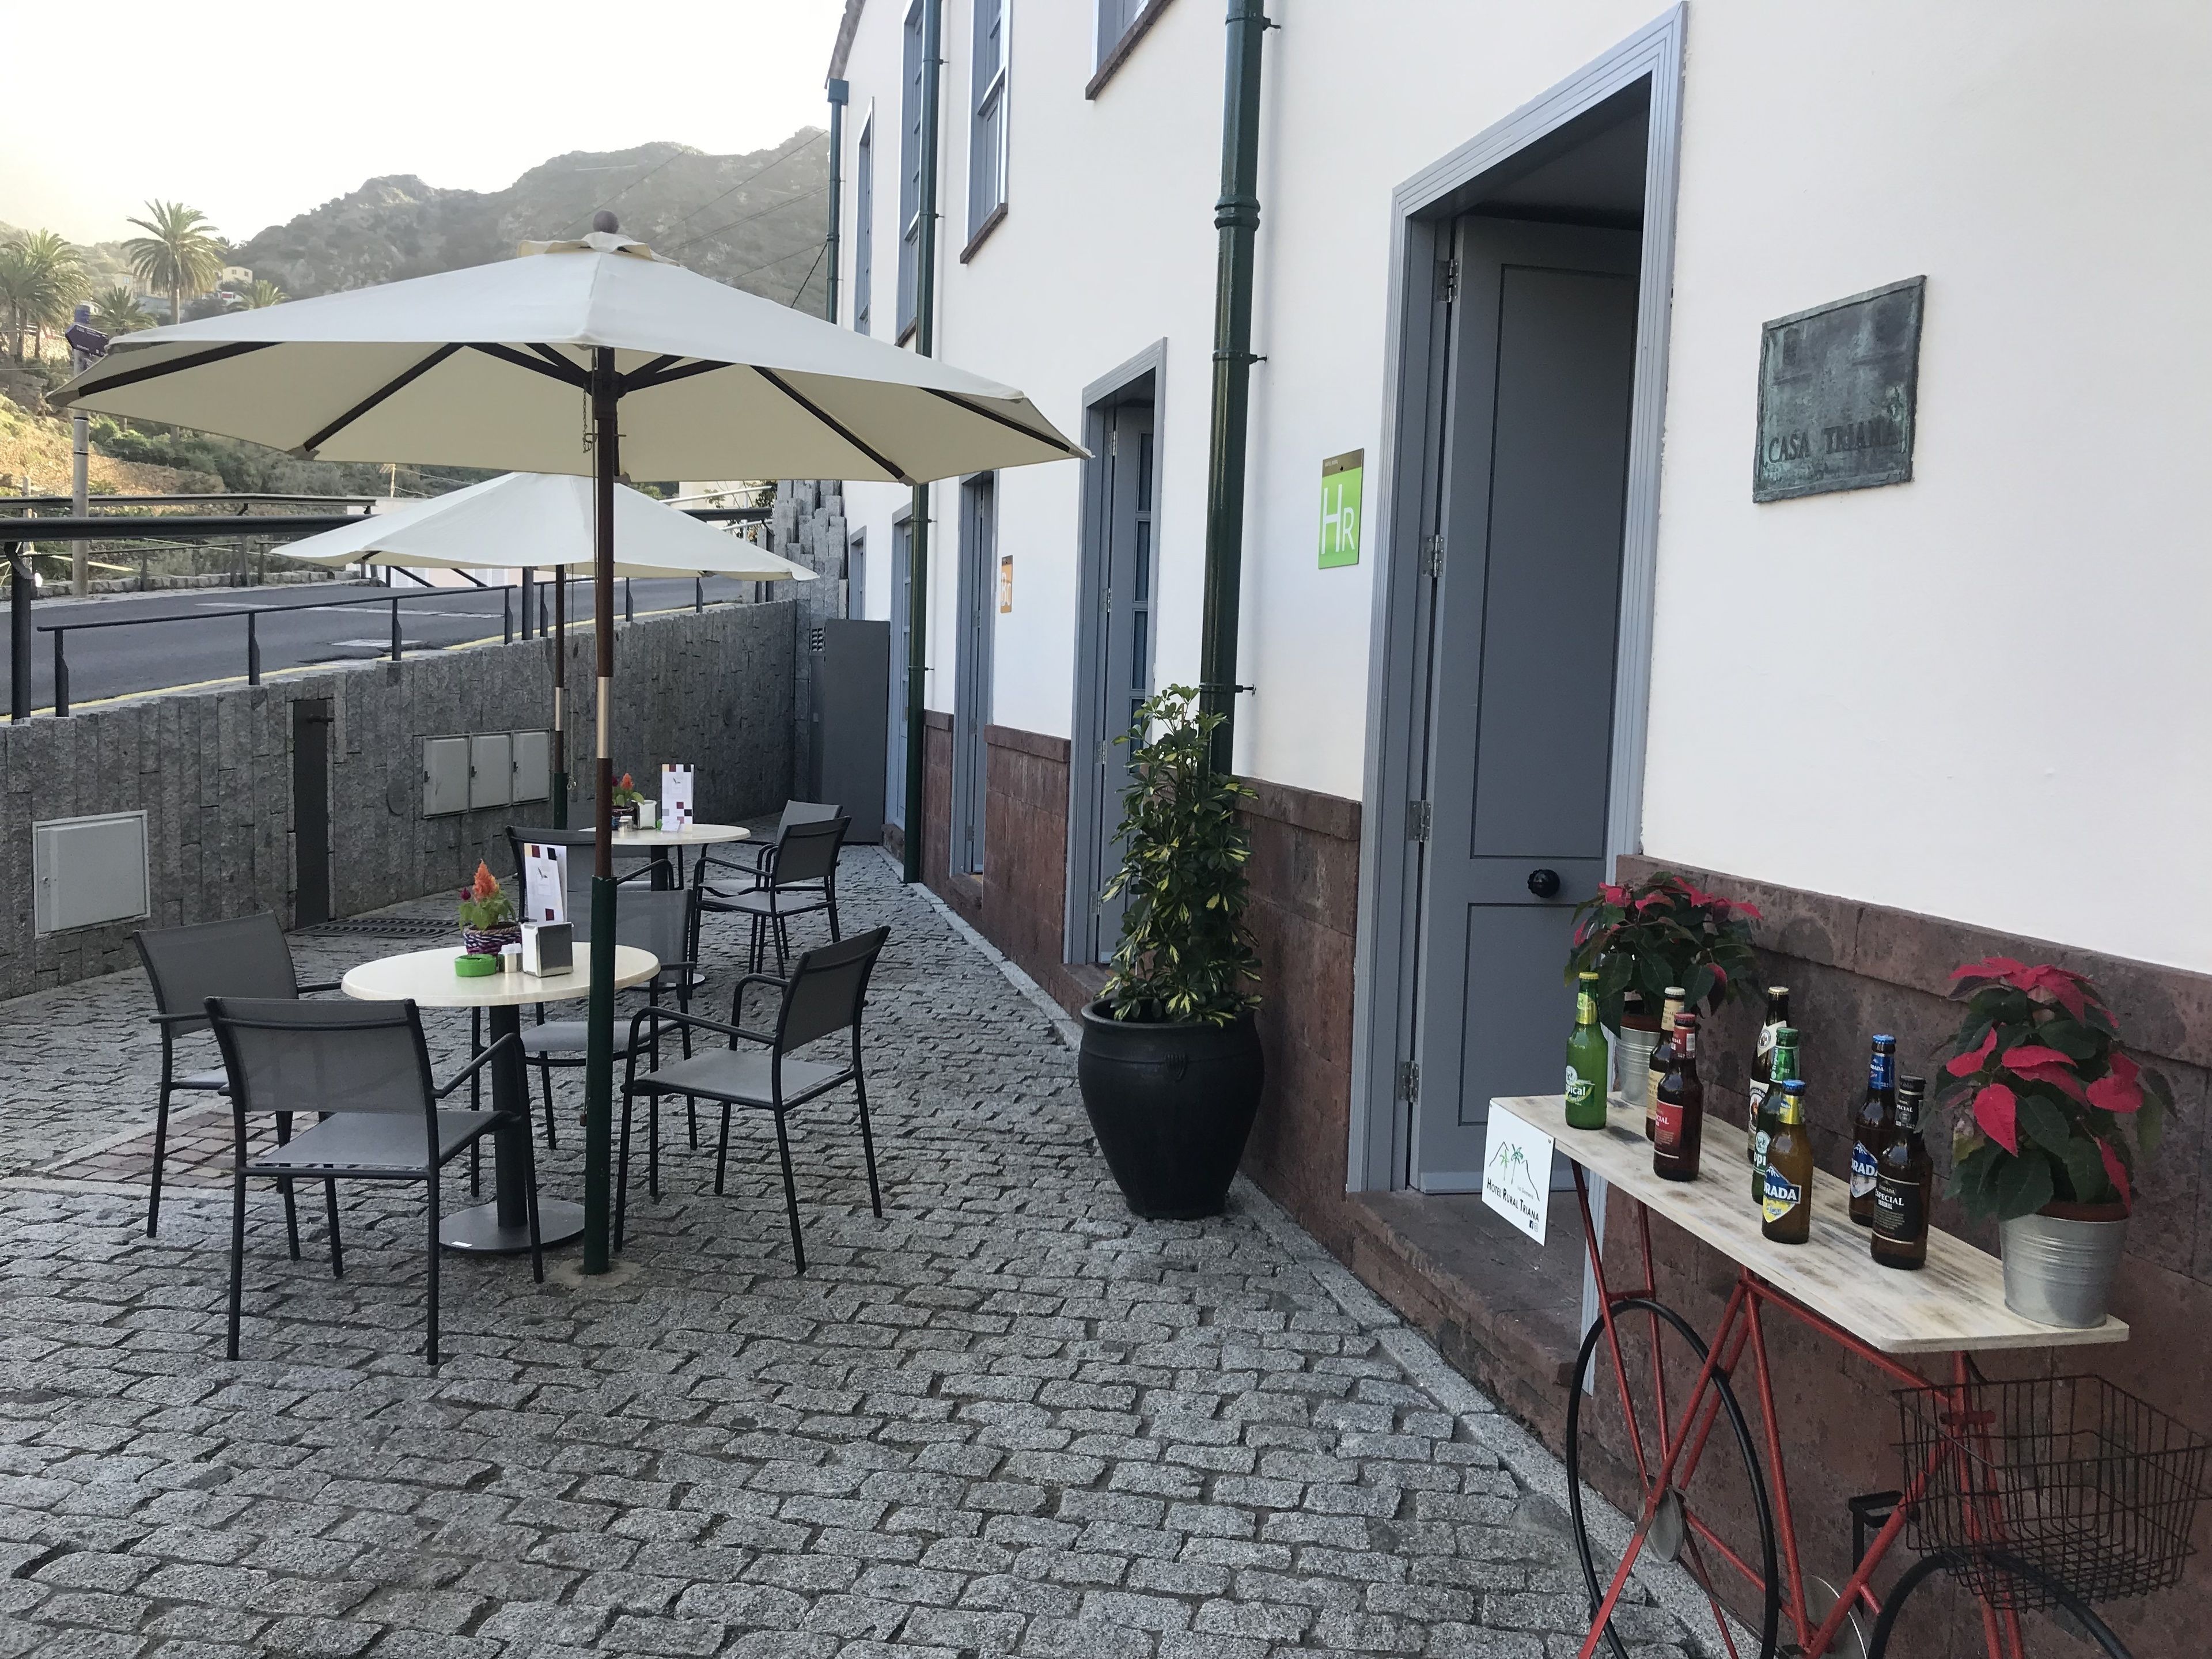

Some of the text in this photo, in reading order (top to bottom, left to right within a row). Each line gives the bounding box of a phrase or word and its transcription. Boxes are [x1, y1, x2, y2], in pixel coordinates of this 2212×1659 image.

[1768, 432, 1810, 463] CASA
[1321, 483, 1355, 554] HR
[1487, 1177, 1539, 1222] HOTEL RURAL TRIANA
[1764, 1181, 1797, 1200] RADA
